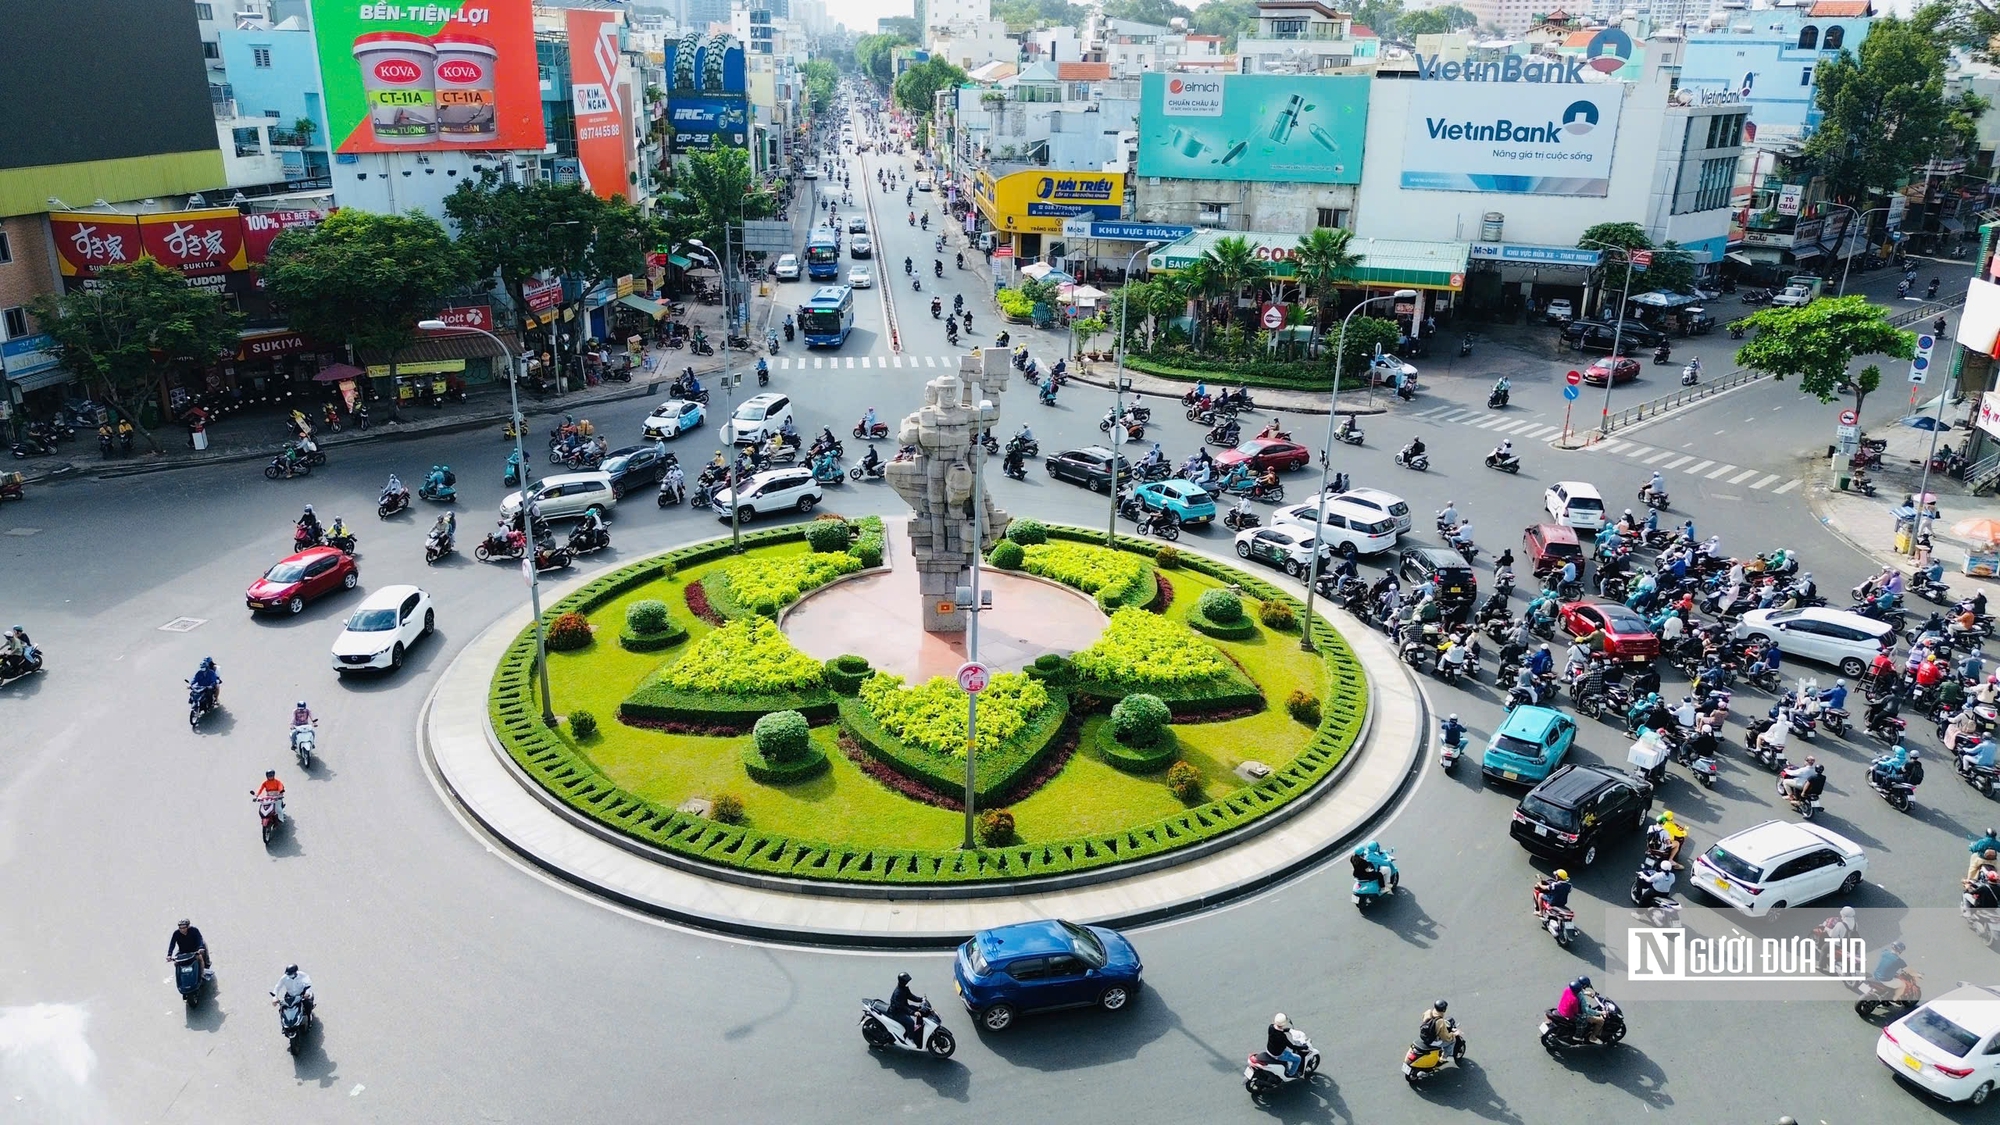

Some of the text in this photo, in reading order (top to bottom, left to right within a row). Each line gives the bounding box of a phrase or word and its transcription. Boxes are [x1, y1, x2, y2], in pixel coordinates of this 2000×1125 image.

[380, 66, 416, 77] KOVA
[443, 66, 477, 78] KOVA
[1415, 53, 1585, 83] VietinBank
[1184, 82, 1220, 92] elmich
[380, 92, 423, 103] CT-11A
[442, 92, 483, 103] CT-11A
[587, 89, 600, 99] KIM
[1701, 87, 1741, 104] VietinBank
[1426, 117, 1562, 143] VietinBank
[676, 133, 709, 142] GP-22
[1492, 150, 1593, 162] Nâng giá trị cuộc sống
[1056, 177, 1077, 191] HẢI
[245, 214, 279, 231] 100%
[294, 210, 311, 220] BEEF
[1122, 227, 1143, 236] VỰC
[1146, 226, 1167, 237] RỬA
[70, 222, 127, 265] すき家
[163, 222, 227, 261] すき家
[1473, 246, 1498, 255] Mobil
[183, 261, 216, 270] SUKIYA
[185, 274, 227, 287] YUDON
[252, 338, 303, 353] SUKIYA
